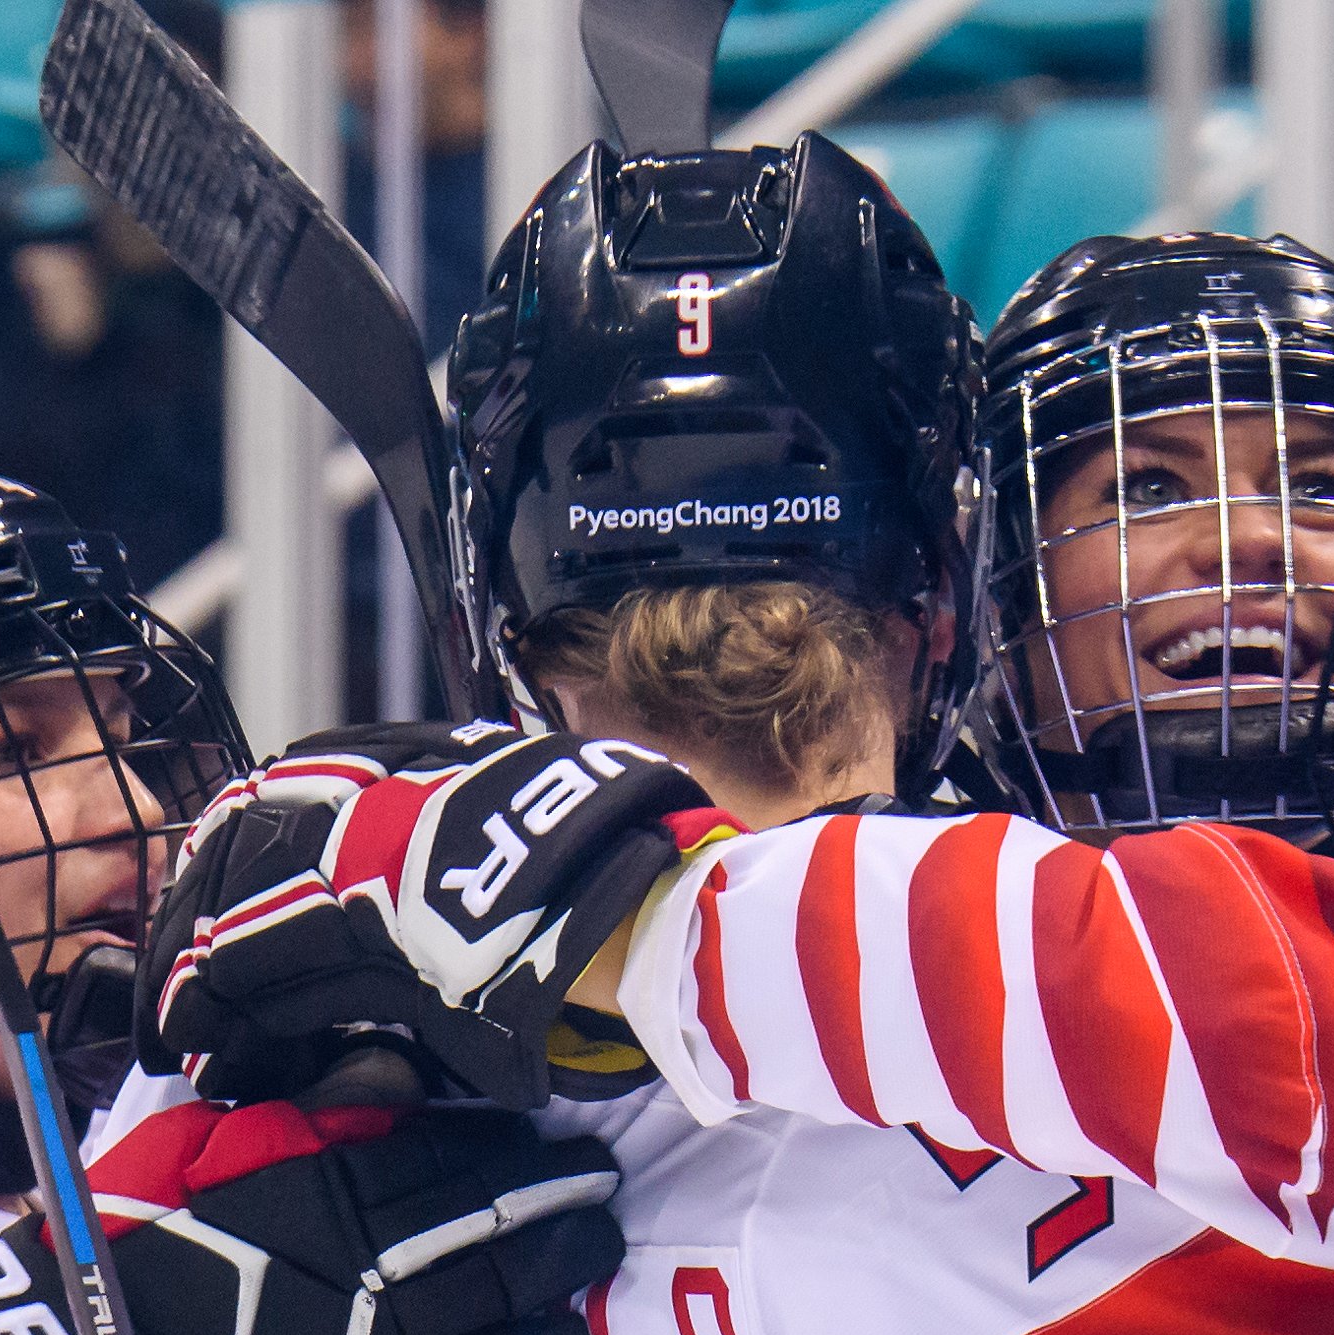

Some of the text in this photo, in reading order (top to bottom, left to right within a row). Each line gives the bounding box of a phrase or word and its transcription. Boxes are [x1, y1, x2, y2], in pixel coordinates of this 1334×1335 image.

[676, 271, 712, 357] 9
[569, 495, 841, 536] PyeongChang 2018
